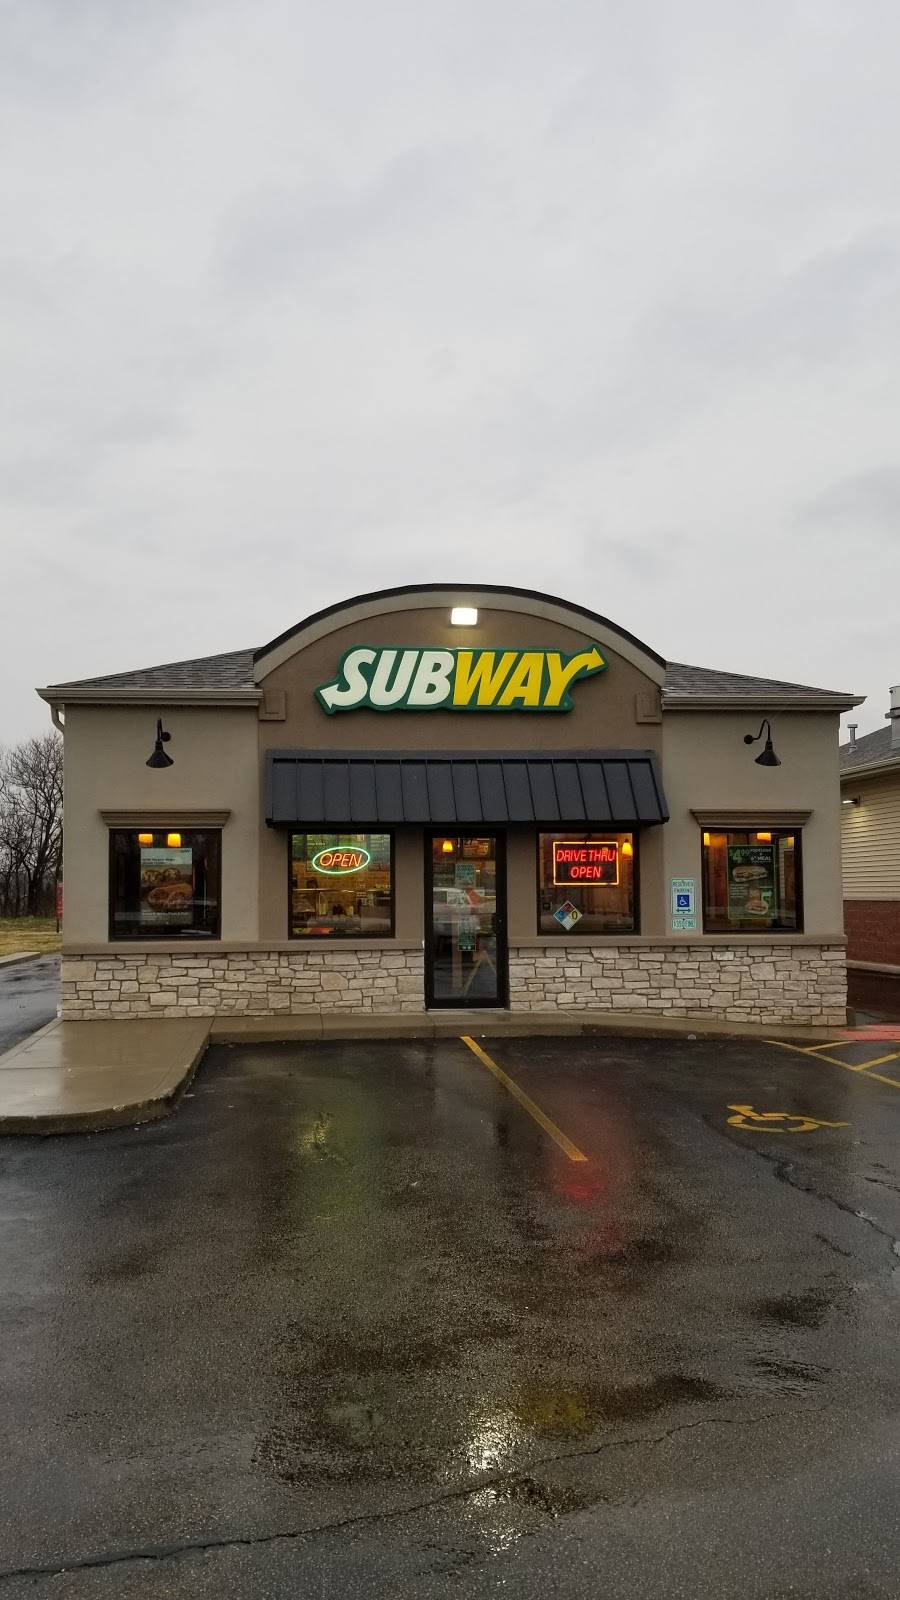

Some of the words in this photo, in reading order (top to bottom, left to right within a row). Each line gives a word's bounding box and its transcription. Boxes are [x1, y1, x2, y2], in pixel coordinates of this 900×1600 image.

[320, 648, 604, 709] SUBWAY
[319, 853, 363, 867] OPEN
[556, 849, 587, 862] DRIVE
[588, 849, 616, 862] THRU
[570, 866, 603, 878] OPEN
